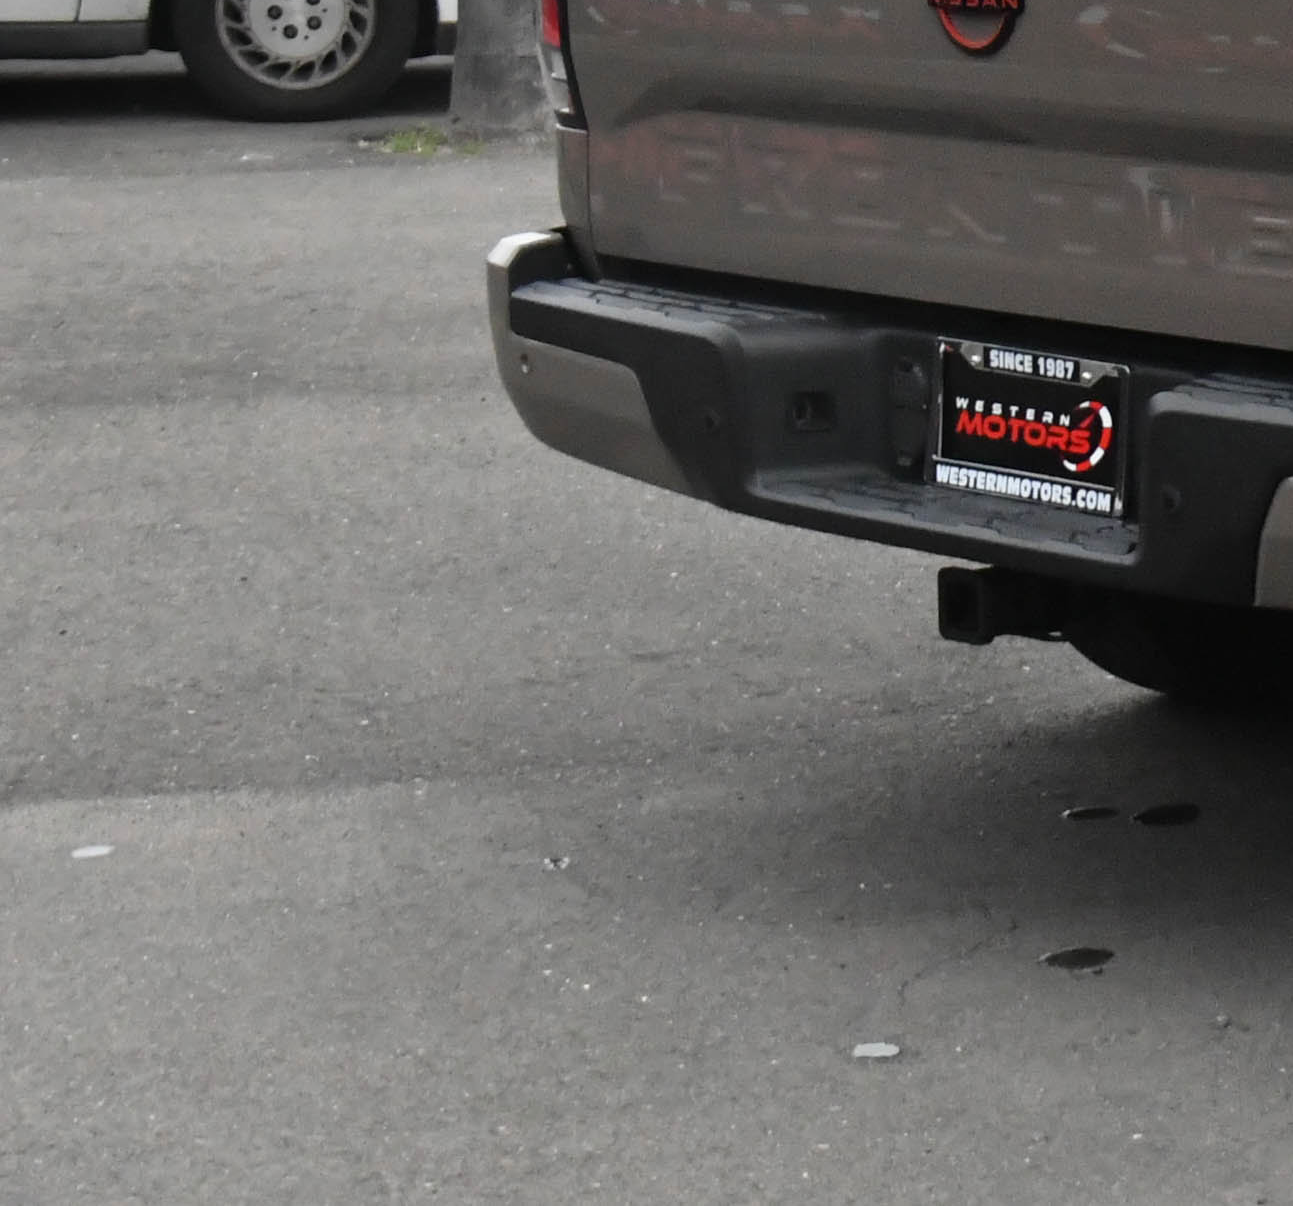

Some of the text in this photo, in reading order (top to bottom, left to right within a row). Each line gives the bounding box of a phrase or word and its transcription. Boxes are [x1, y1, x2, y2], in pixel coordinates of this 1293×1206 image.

[989, 349, 1075, 379] SINCE 1987
[955, 396, 1070, 427] WESTERN
[955, 410, 1091, 454] MOTORS
[936, 463, 1111, 512] WESTERNMOTORS.COM
